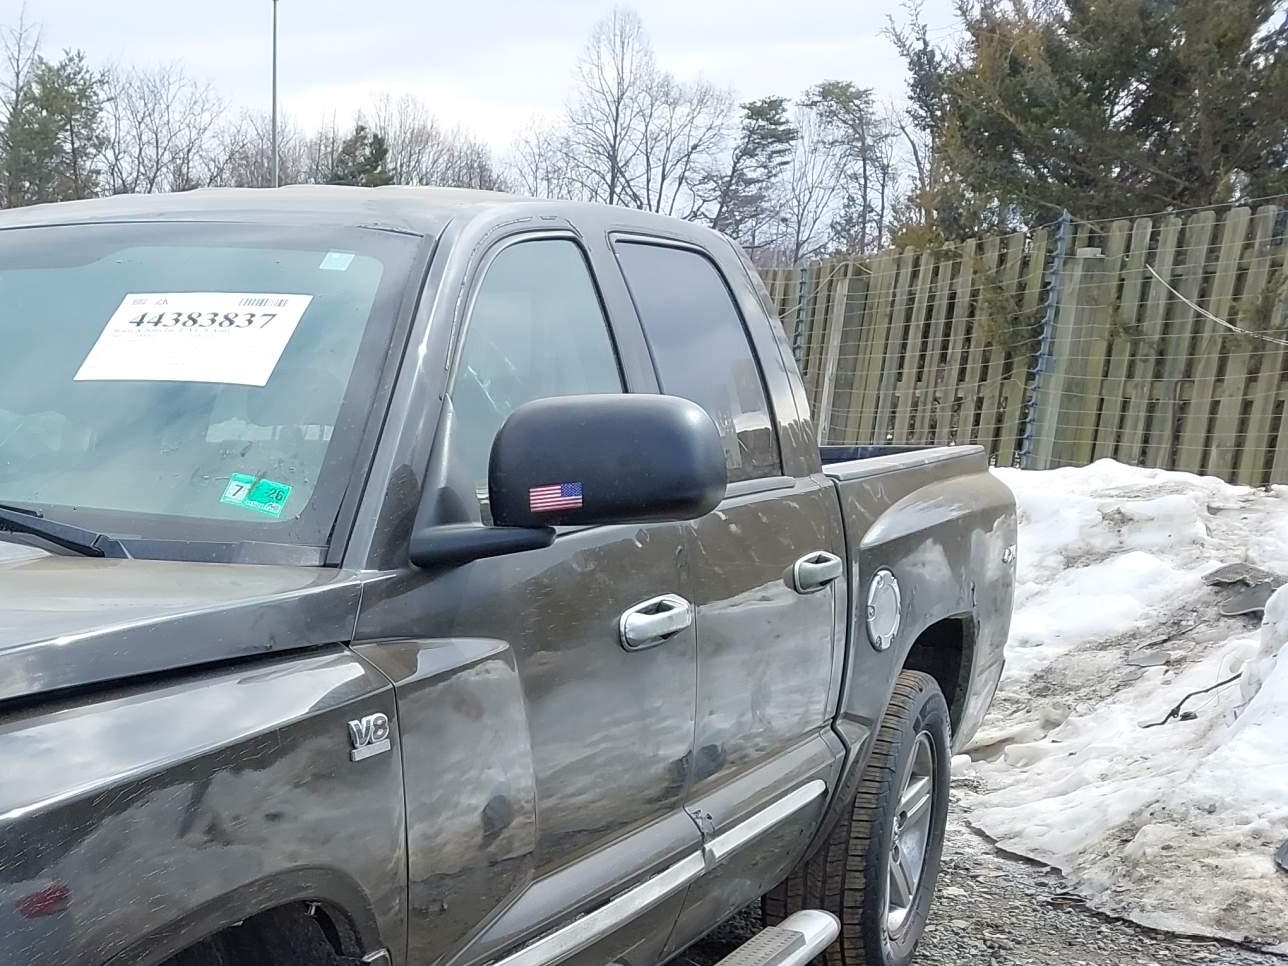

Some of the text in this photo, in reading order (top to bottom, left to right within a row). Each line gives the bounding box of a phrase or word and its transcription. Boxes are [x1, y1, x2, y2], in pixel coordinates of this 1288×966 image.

[129, 311, 278, 328] 44383837
[232, 484, 244, 497] 7
[347, 712, 390, 750] V8
